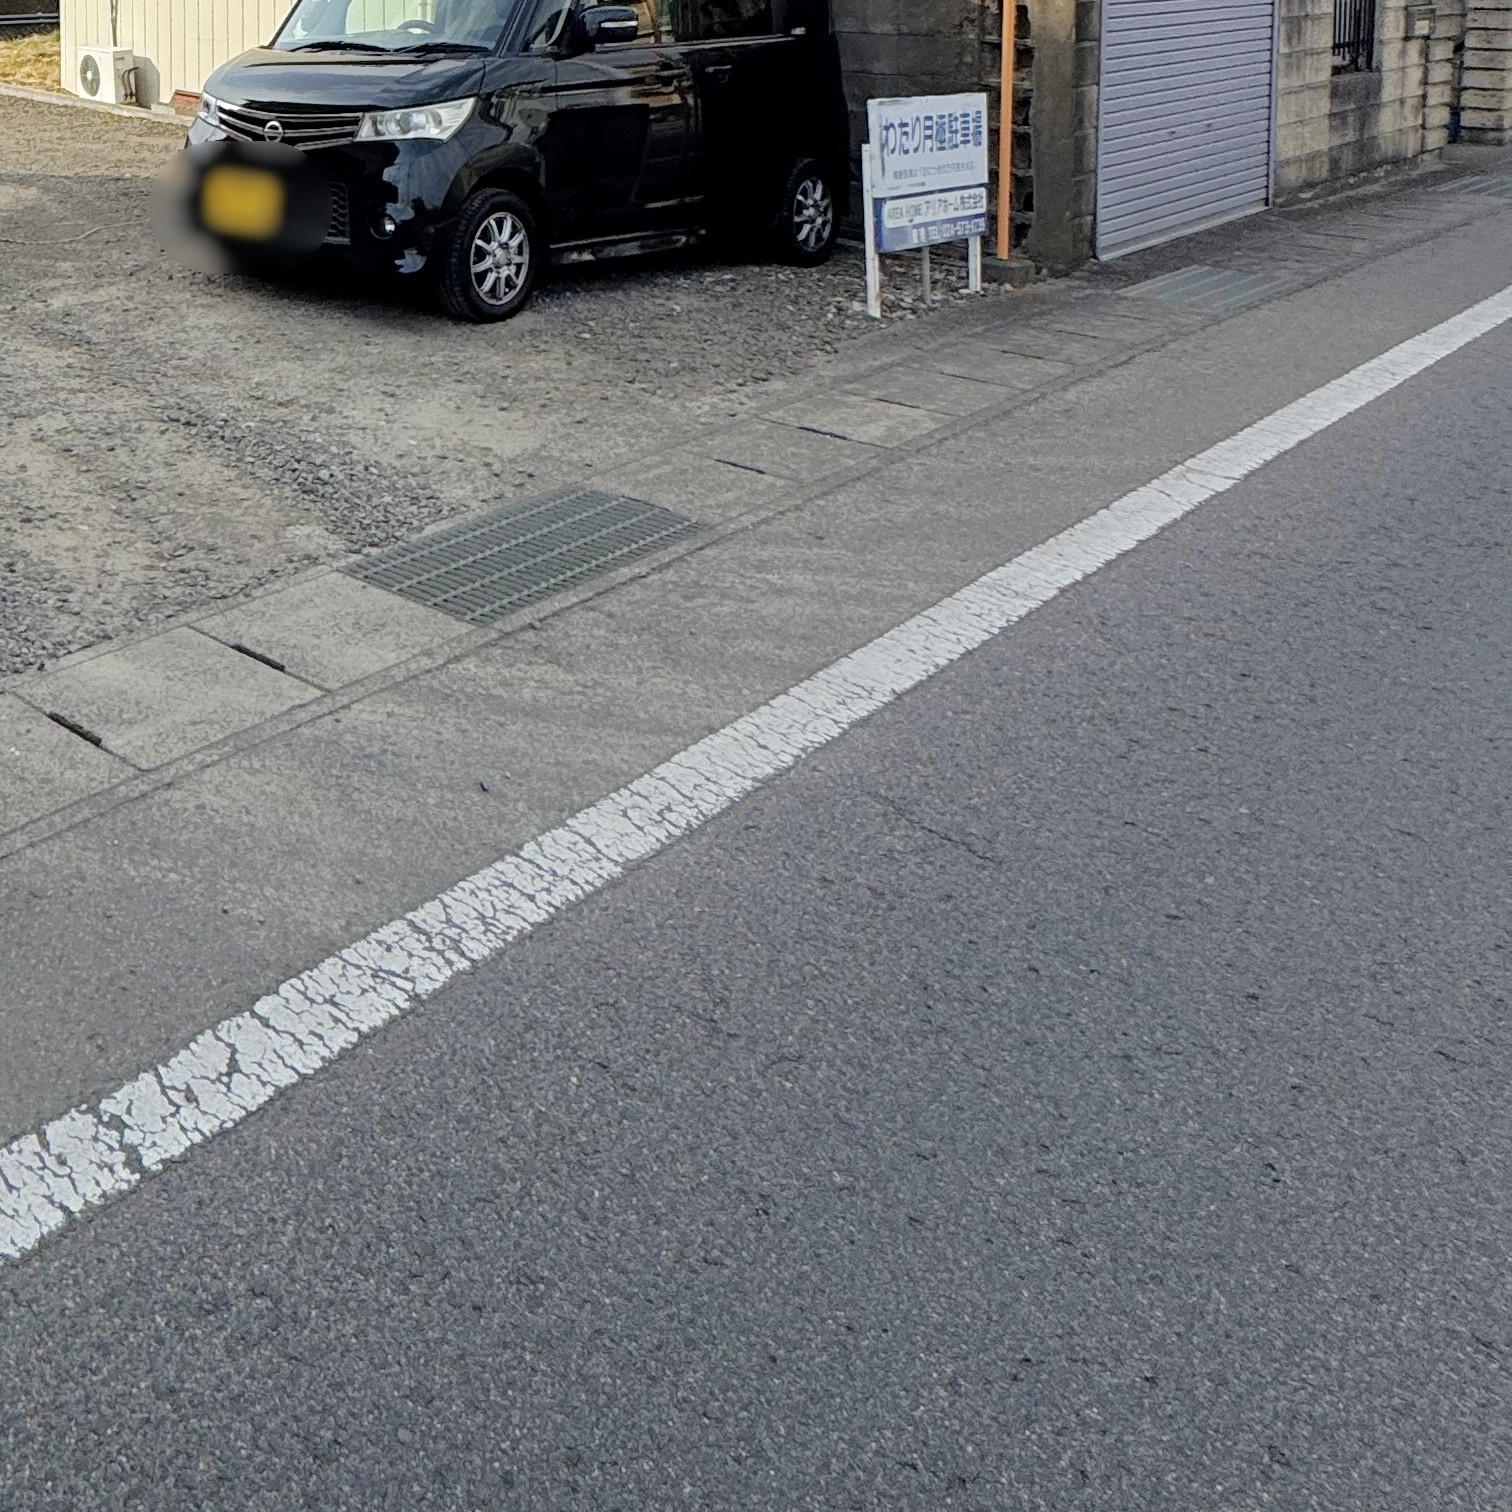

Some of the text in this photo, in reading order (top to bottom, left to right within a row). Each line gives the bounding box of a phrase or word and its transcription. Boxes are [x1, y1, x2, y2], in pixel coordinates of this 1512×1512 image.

[882, 110, 983, 157] わたり月極駐車場
